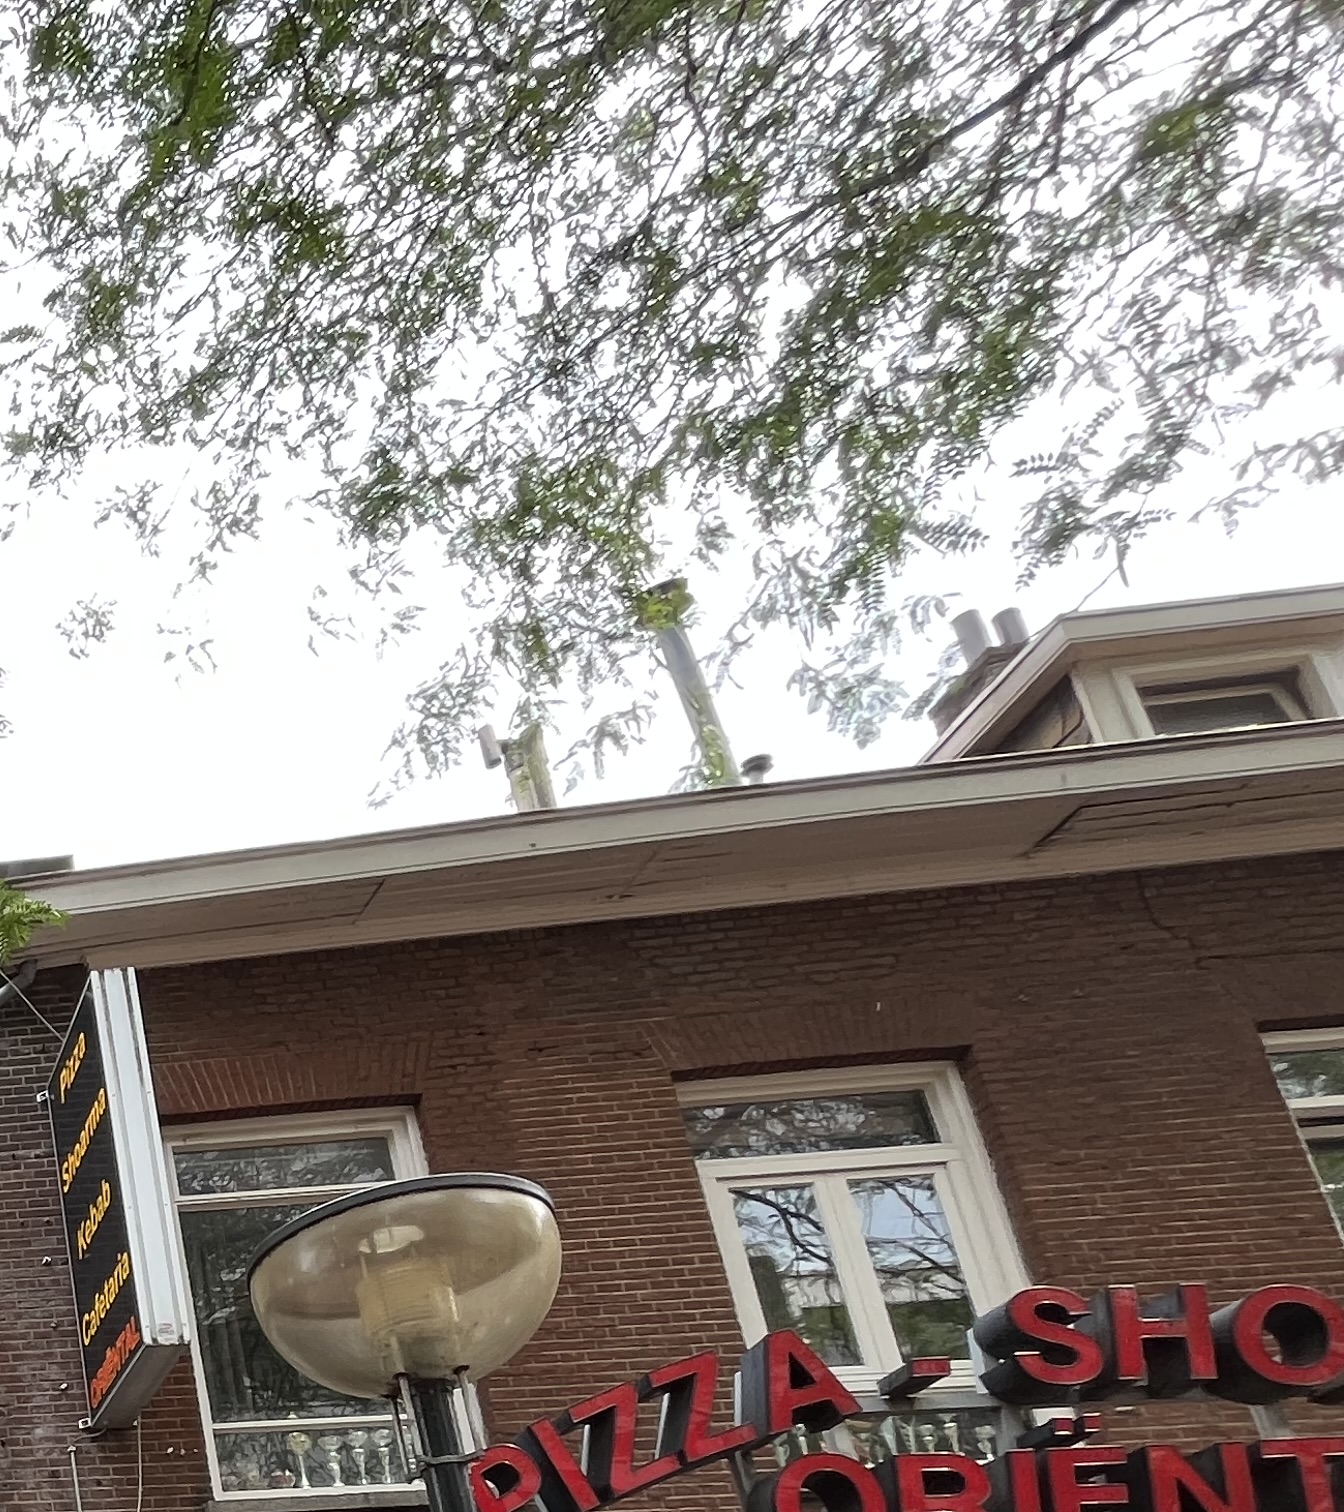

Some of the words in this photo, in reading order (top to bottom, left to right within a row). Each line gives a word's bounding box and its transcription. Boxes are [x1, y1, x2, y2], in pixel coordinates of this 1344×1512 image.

[59, 1032, 86, 1104] Pizza
[61, 1088, 107, 1194] Shoarma
[76, 1179, 111, 1260] Kebab
[81, 1252, 130, 1346] Cafetaria
[1009, 1283, 1344, 1386] SHO
